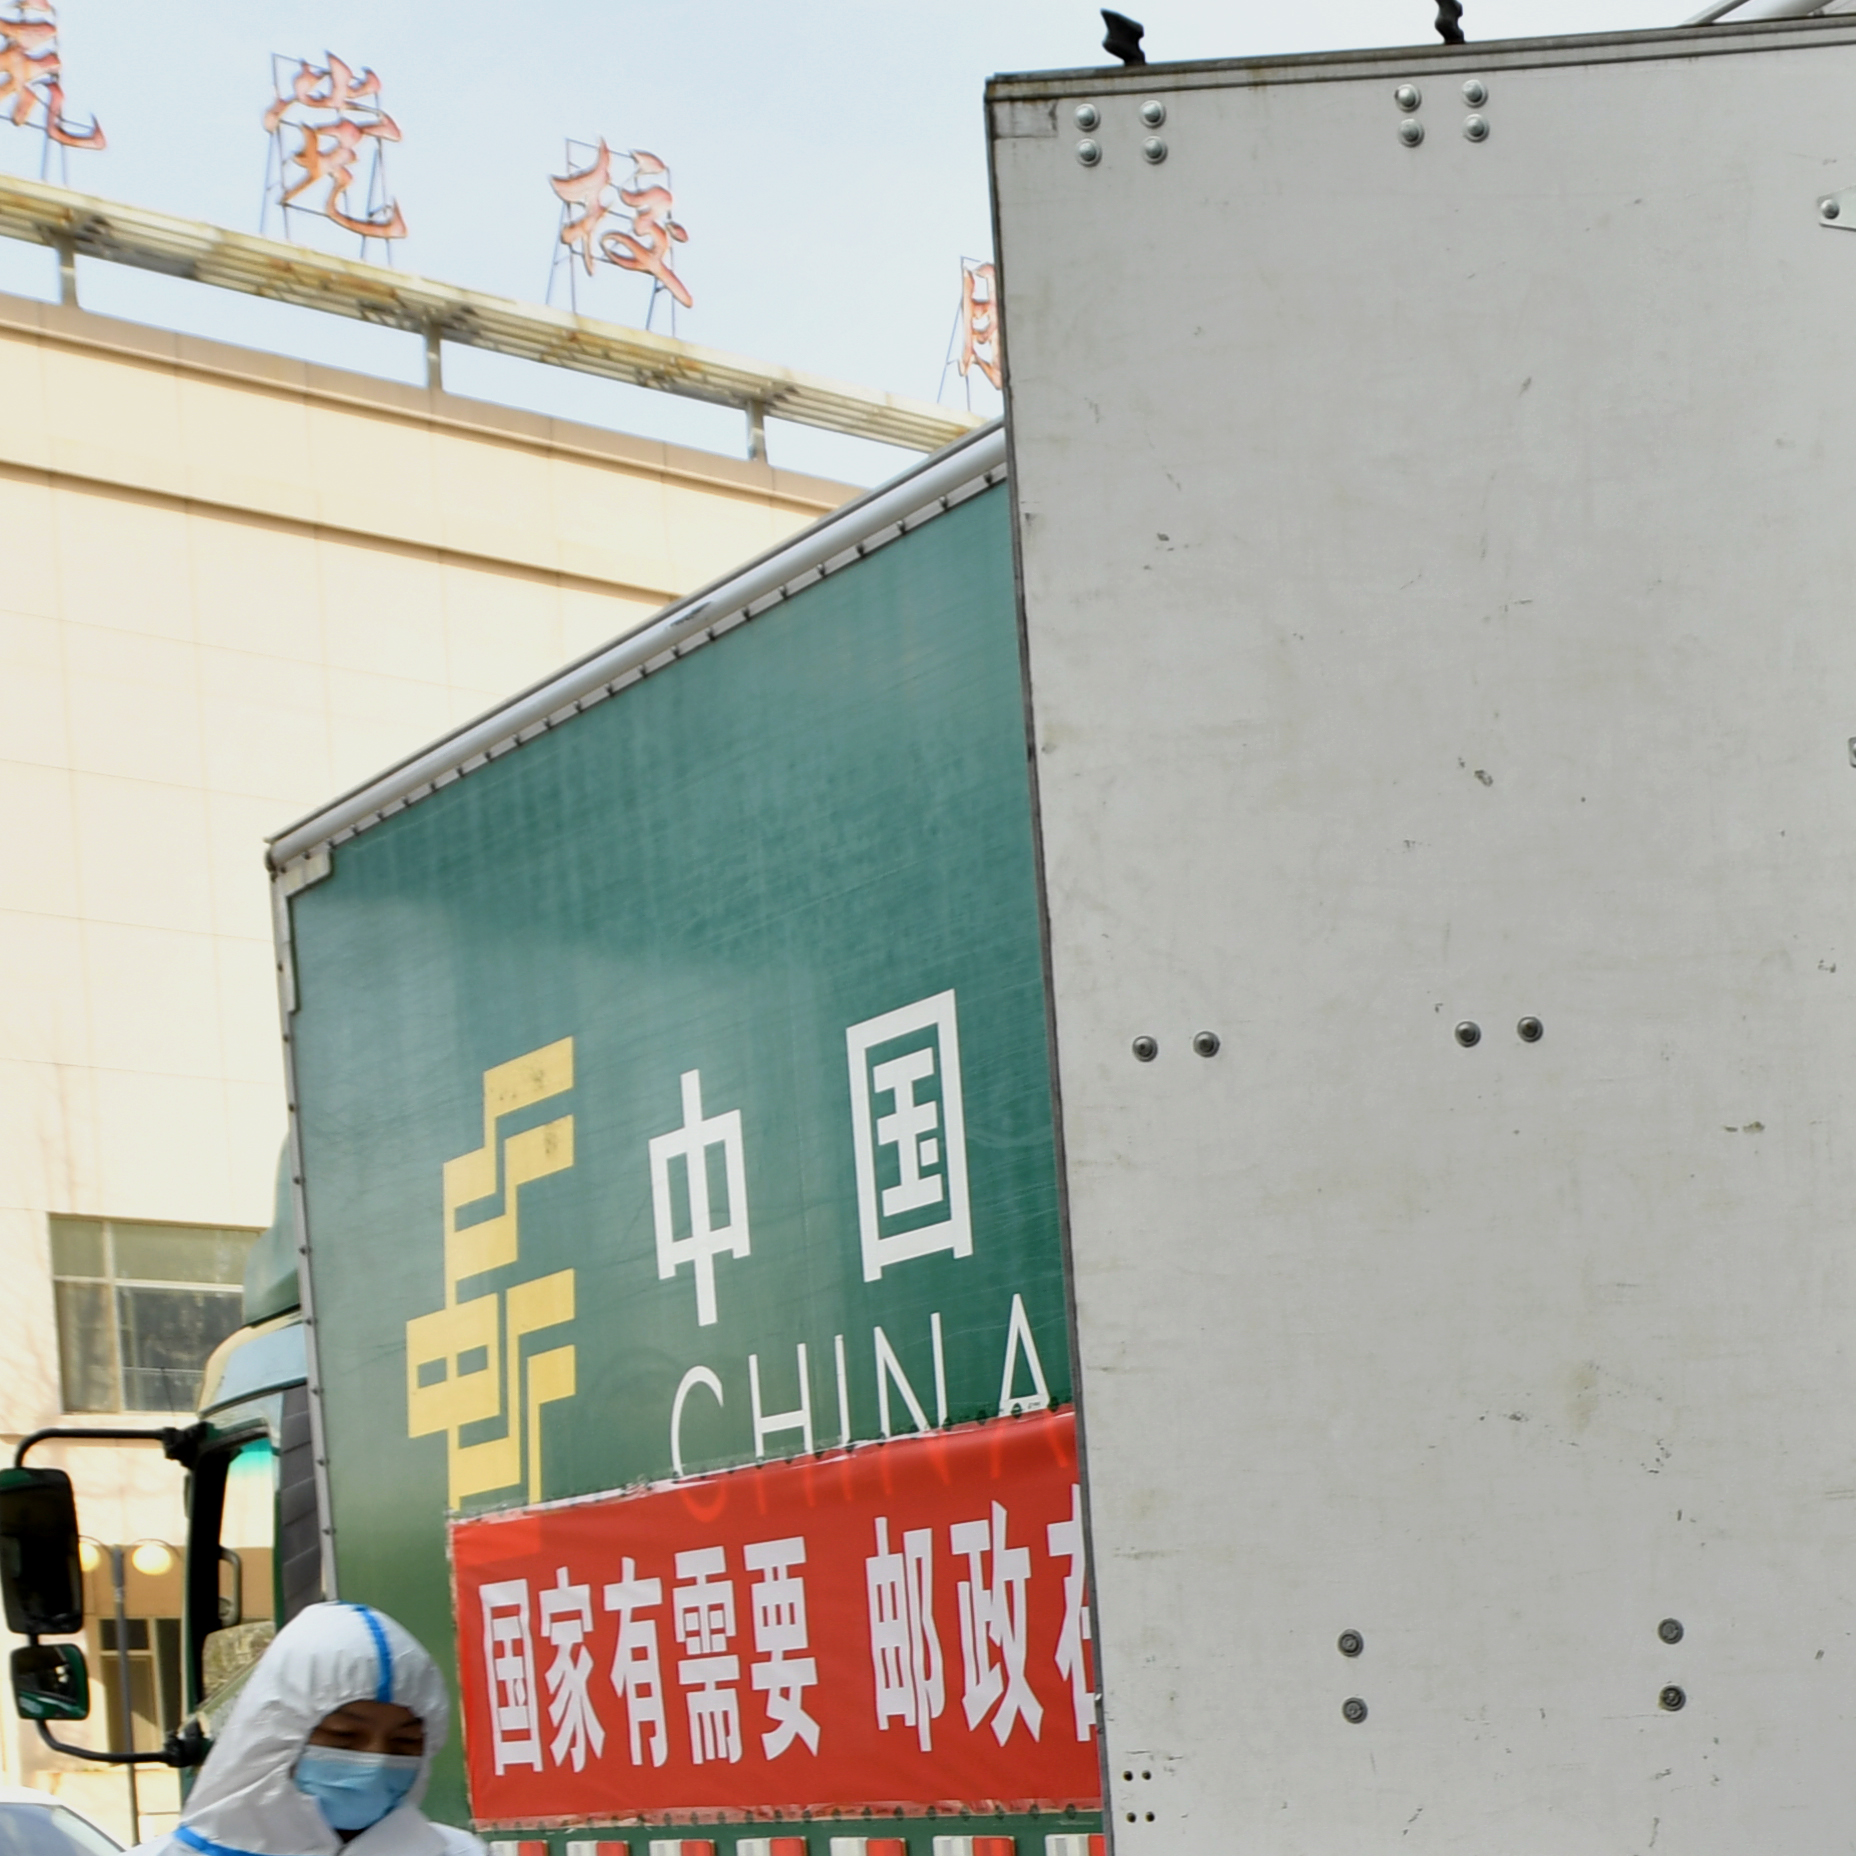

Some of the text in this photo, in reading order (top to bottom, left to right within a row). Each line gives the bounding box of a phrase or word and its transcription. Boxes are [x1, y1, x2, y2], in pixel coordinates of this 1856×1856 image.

[648, 988, 972, 1326] 中国
[669, 1293, 1051, 1482] CHINA
[479, 1535, 820, 1776] 国家有需要
